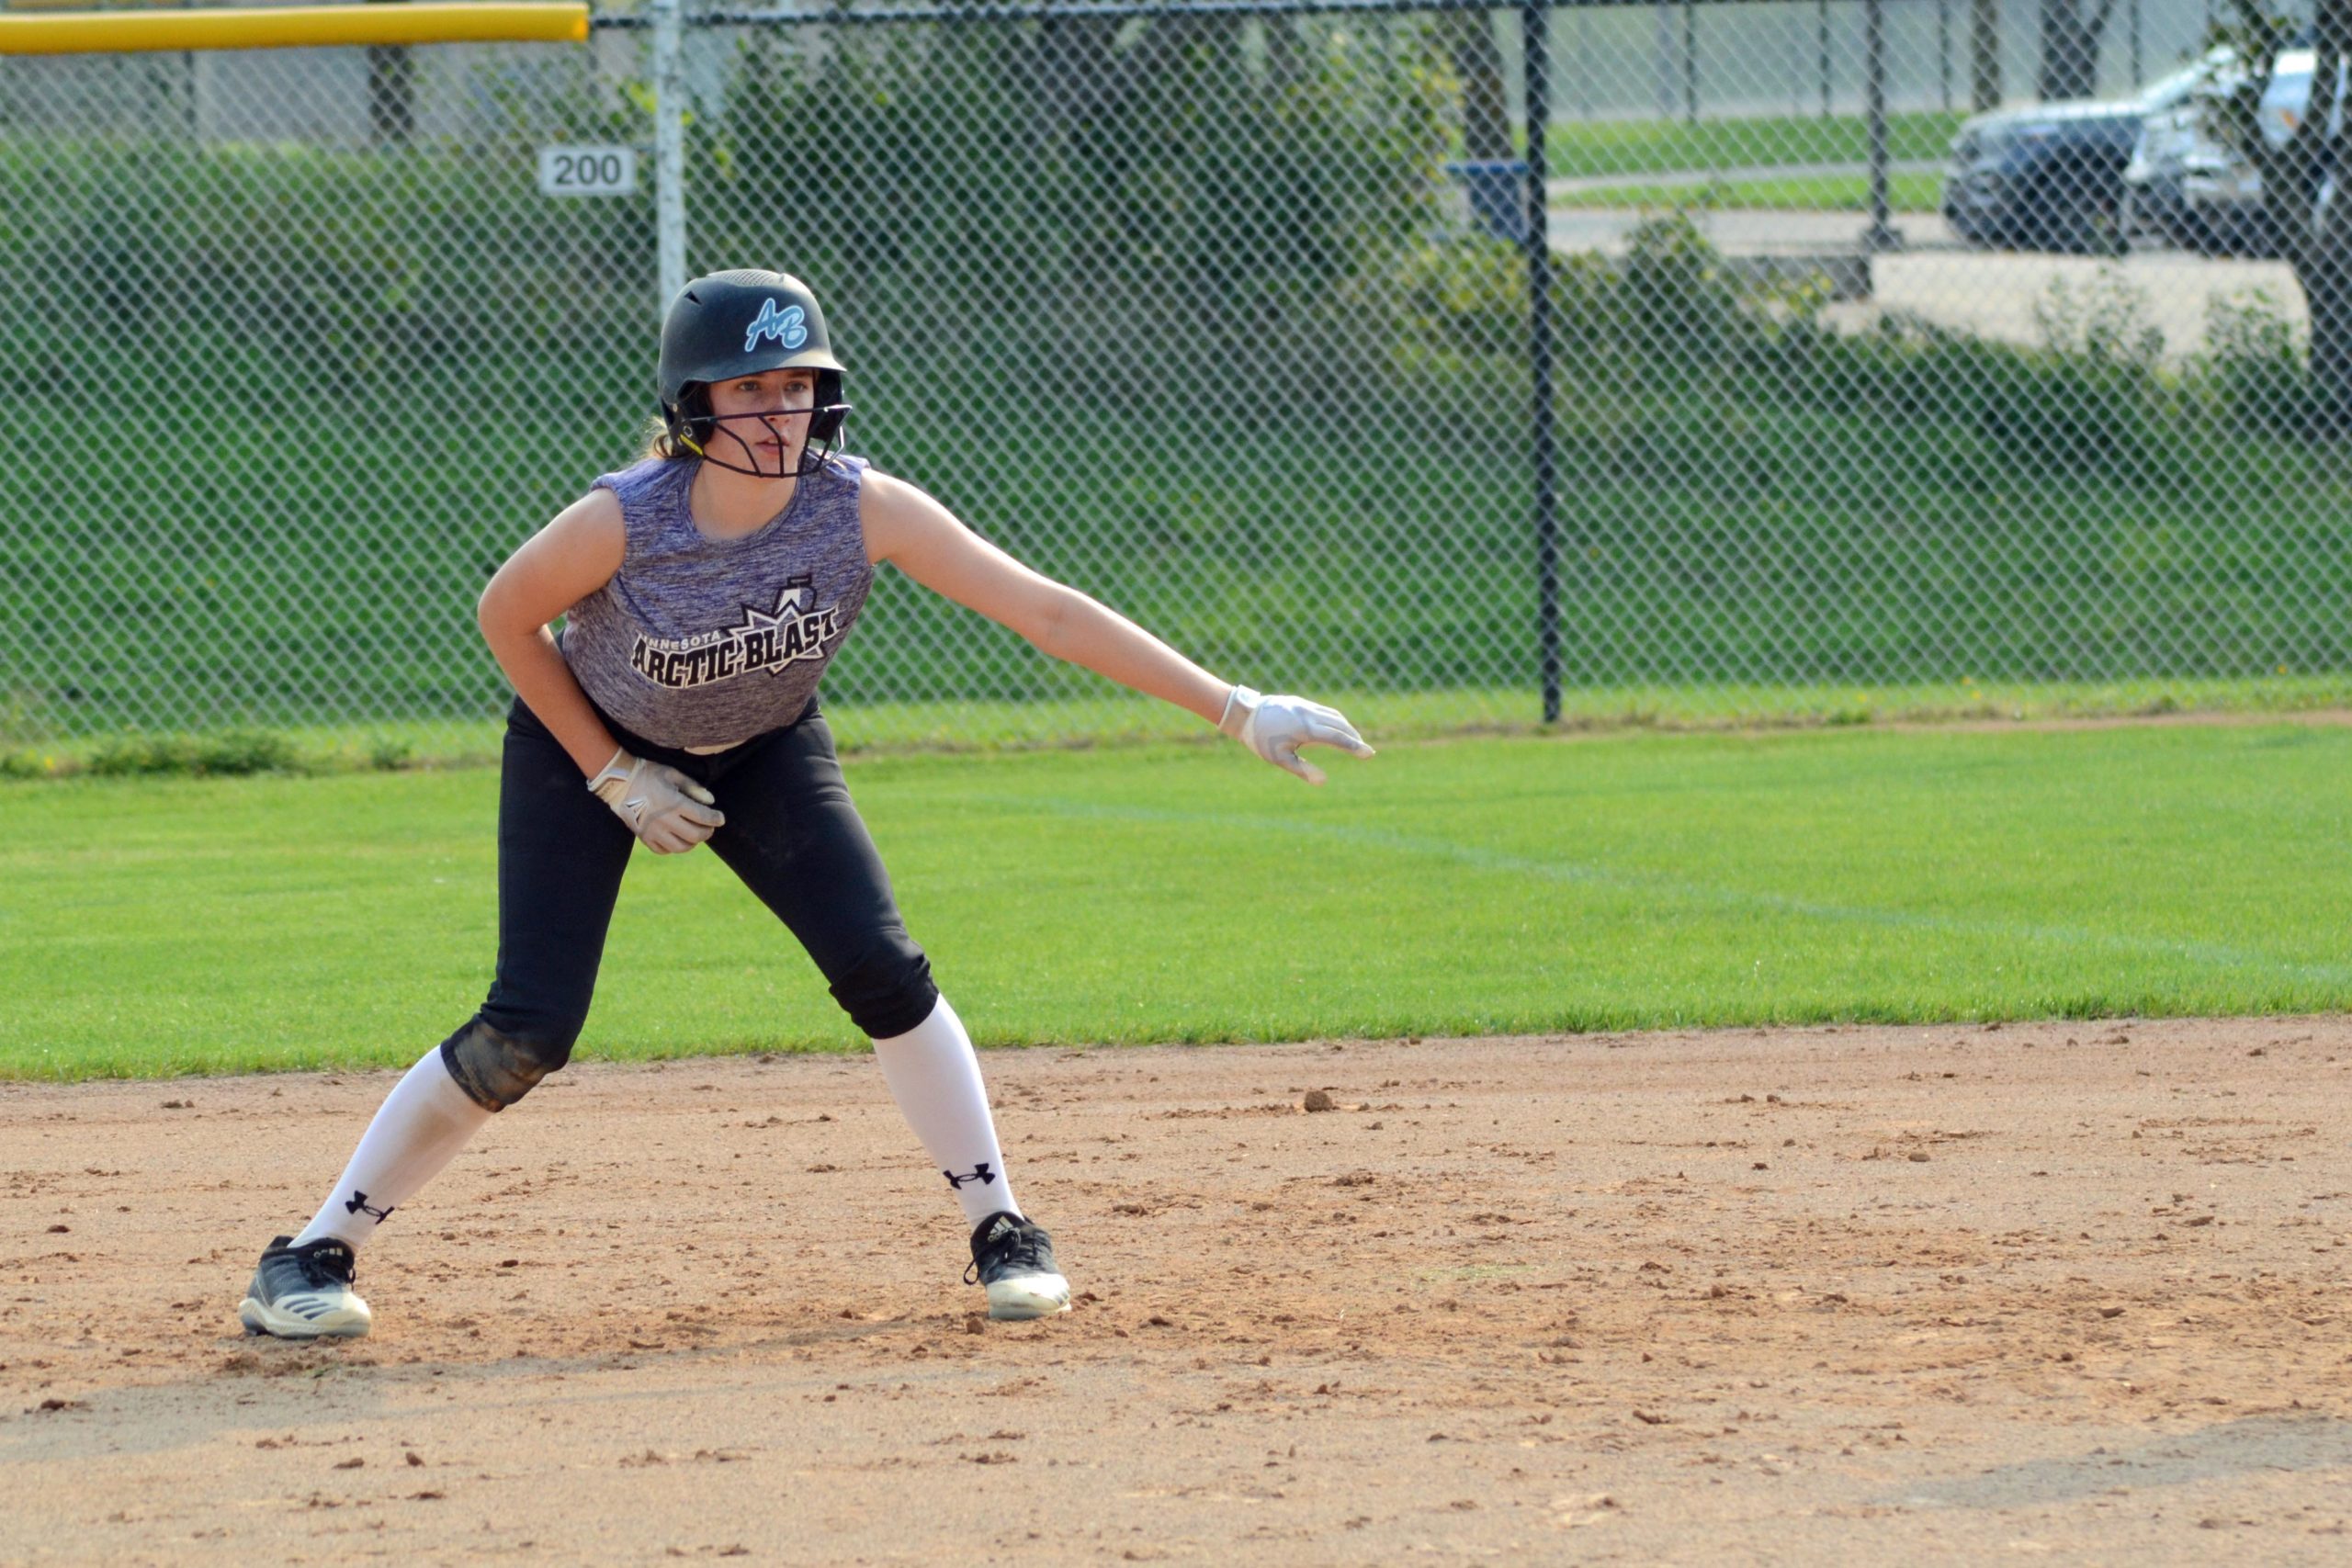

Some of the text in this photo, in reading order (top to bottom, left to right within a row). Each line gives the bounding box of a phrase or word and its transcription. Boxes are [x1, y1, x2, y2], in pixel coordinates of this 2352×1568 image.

[553, 153, 621, 186] 200
[744, 297, 808, 353] AB
[631, 604, 841, 689] ARCTIC BLAST
[636, 629, 721, 650] INNESOTA
